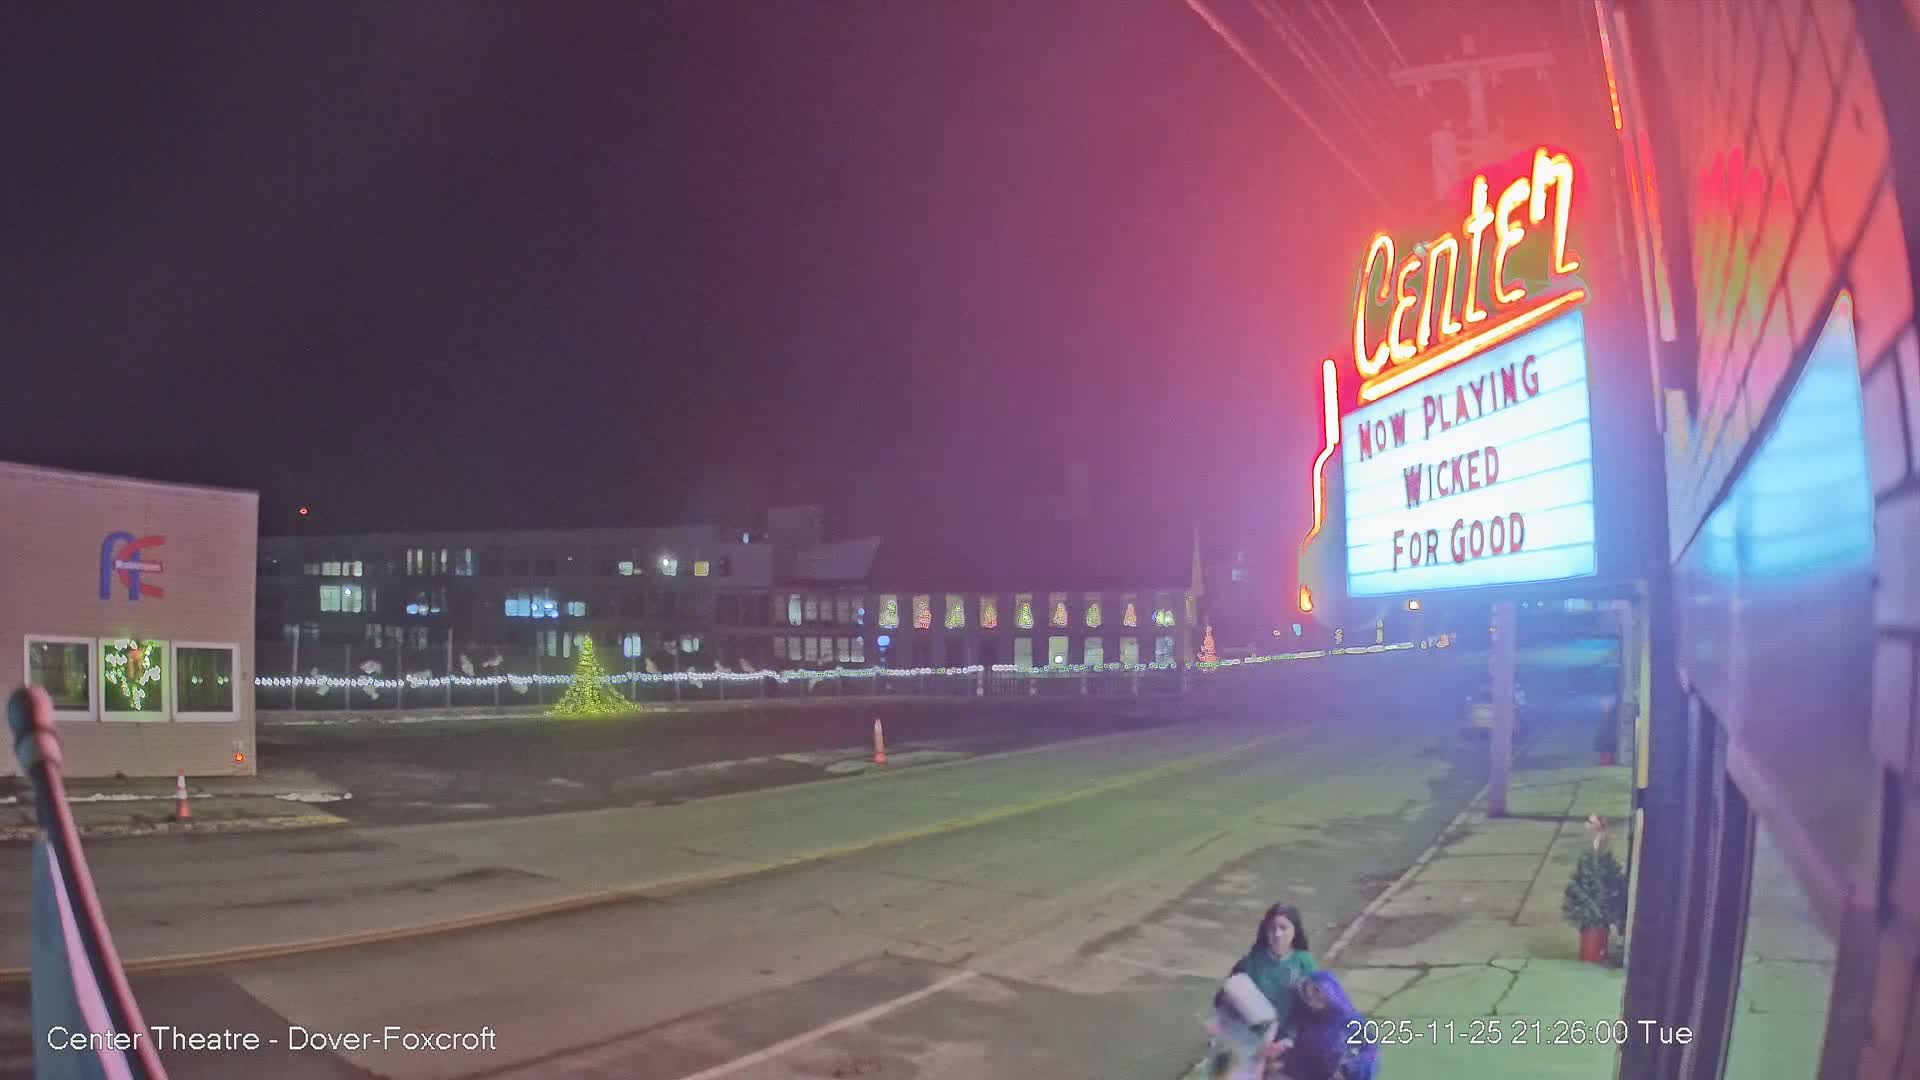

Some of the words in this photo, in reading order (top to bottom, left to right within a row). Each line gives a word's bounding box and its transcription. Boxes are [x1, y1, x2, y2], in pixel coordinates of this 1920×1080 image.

[1358, 409, 1406, 462] NOW
[1423, 354, 1539, 440] PLAYING
[1403, 446, 1499, 509] WICKED
[1393, 529, 1438, 572] FOR
[1451, 512, 1525, 564] GOOD
